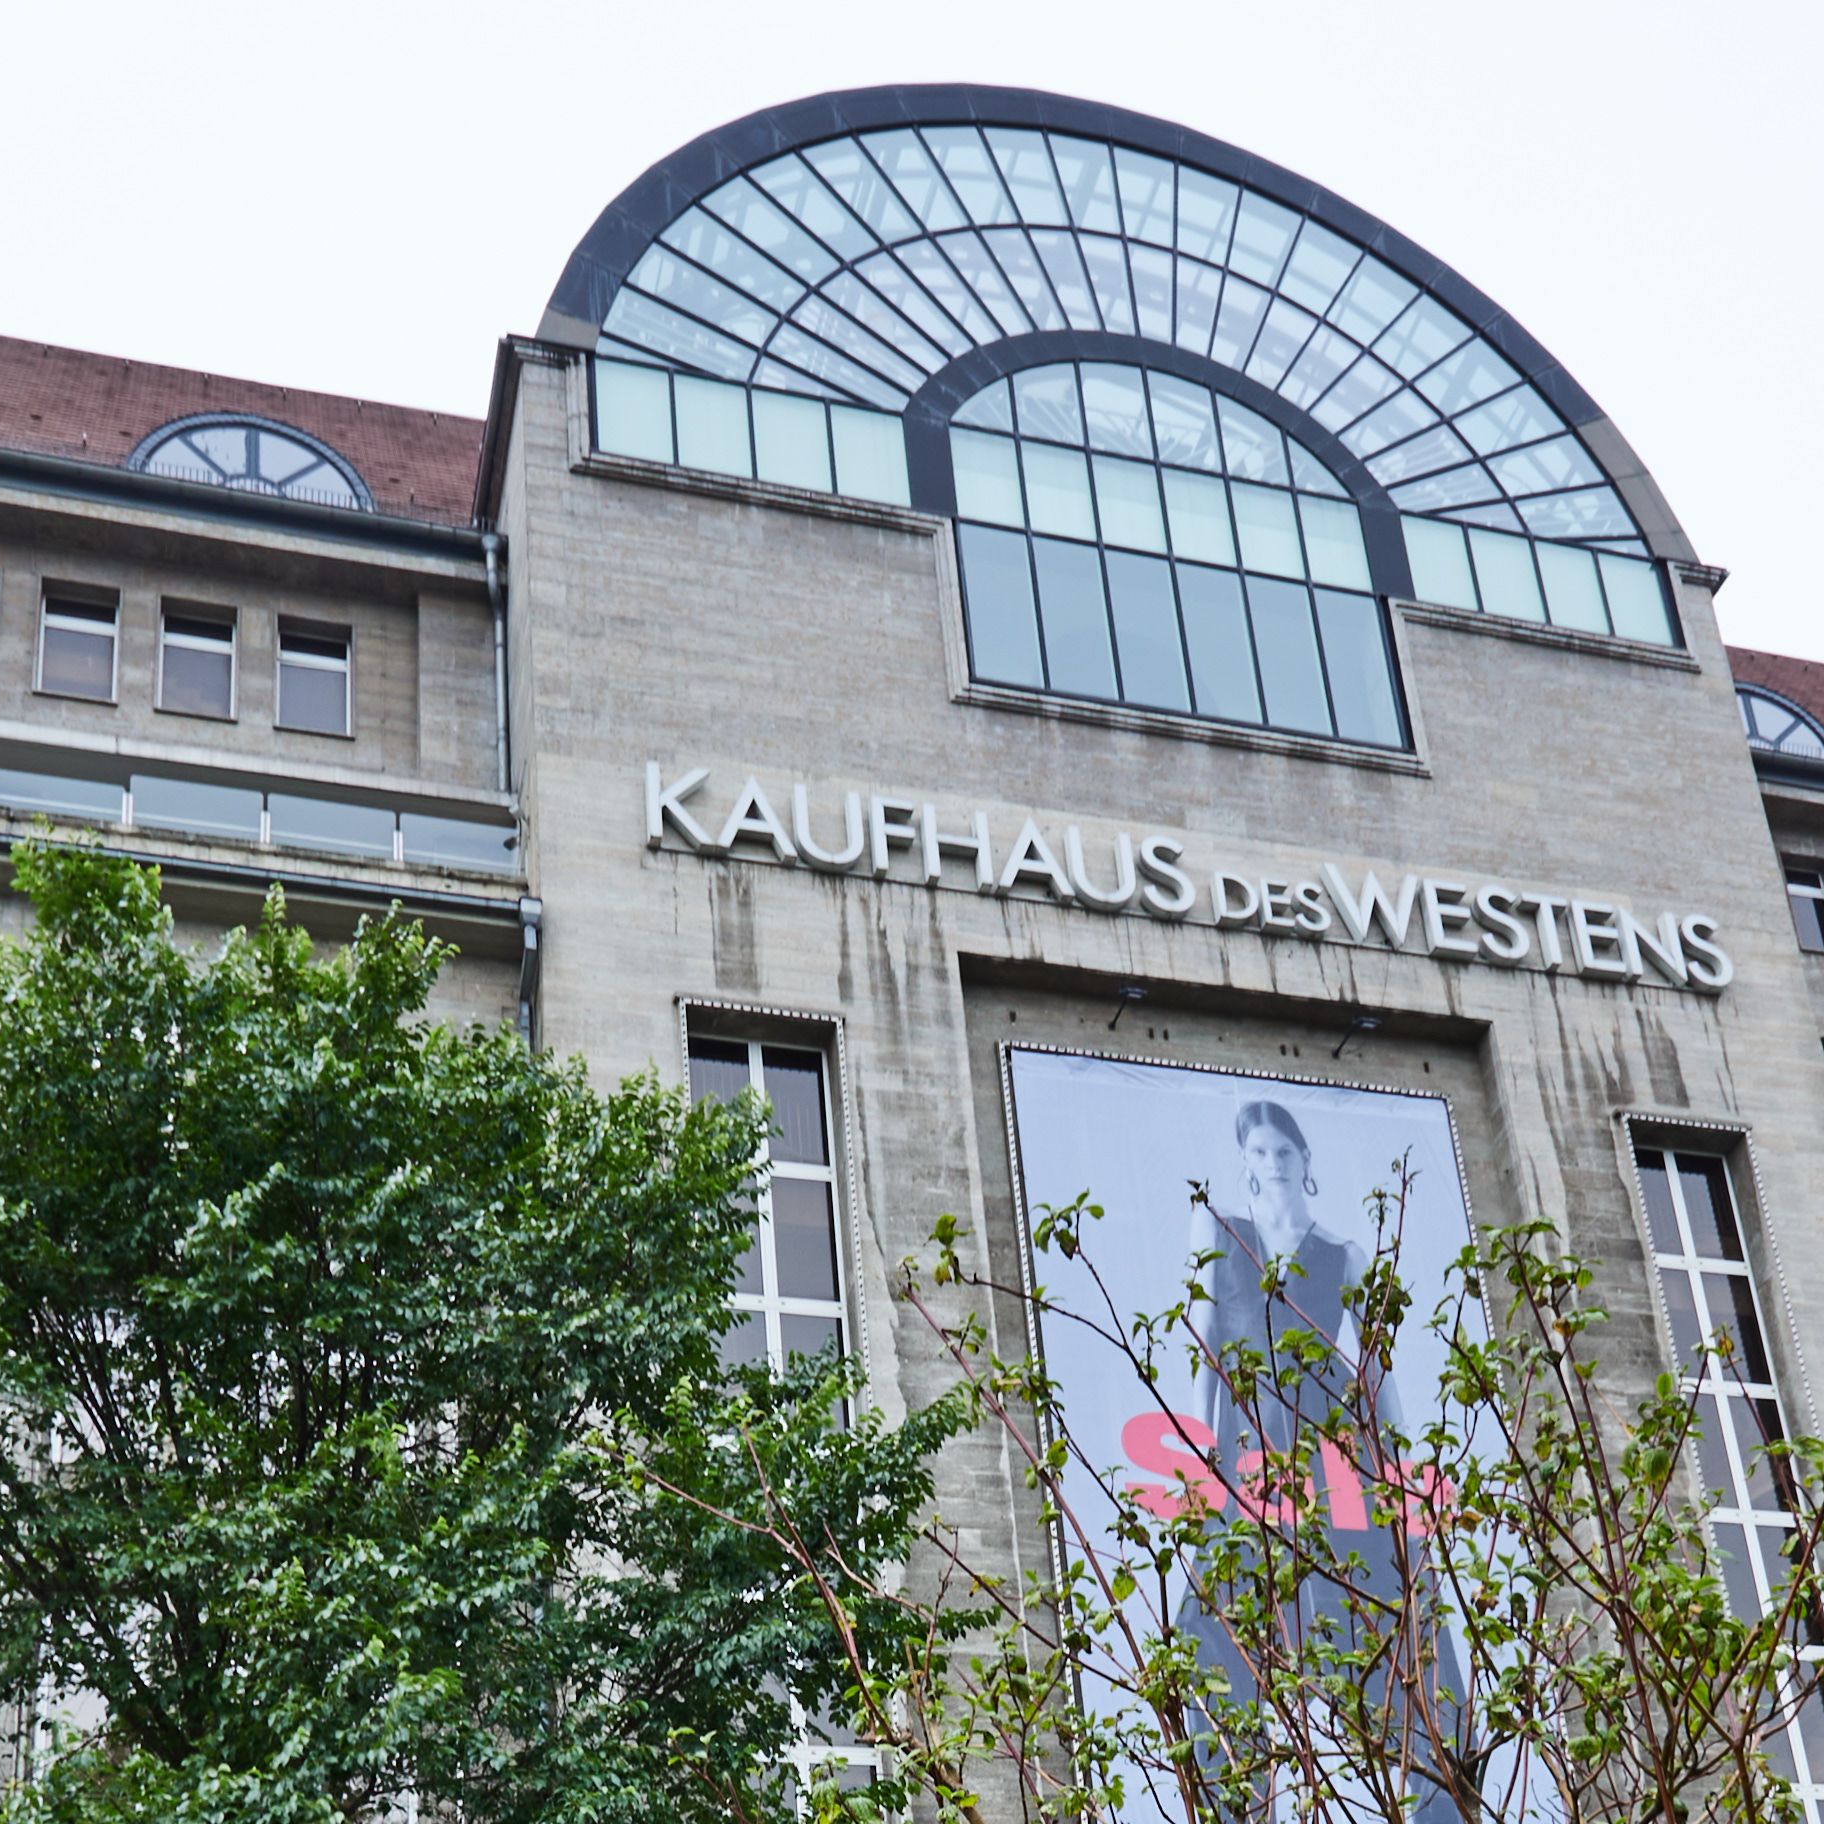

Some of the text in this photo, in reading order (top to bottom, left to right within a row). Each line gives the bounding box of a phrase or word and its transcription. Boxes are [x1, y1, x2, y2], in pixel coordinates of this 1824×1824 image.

[646, 761, 1734, 994] KAUFHAUS DES WESTENS
[1121, 1411, 1459, 1538] Sale
